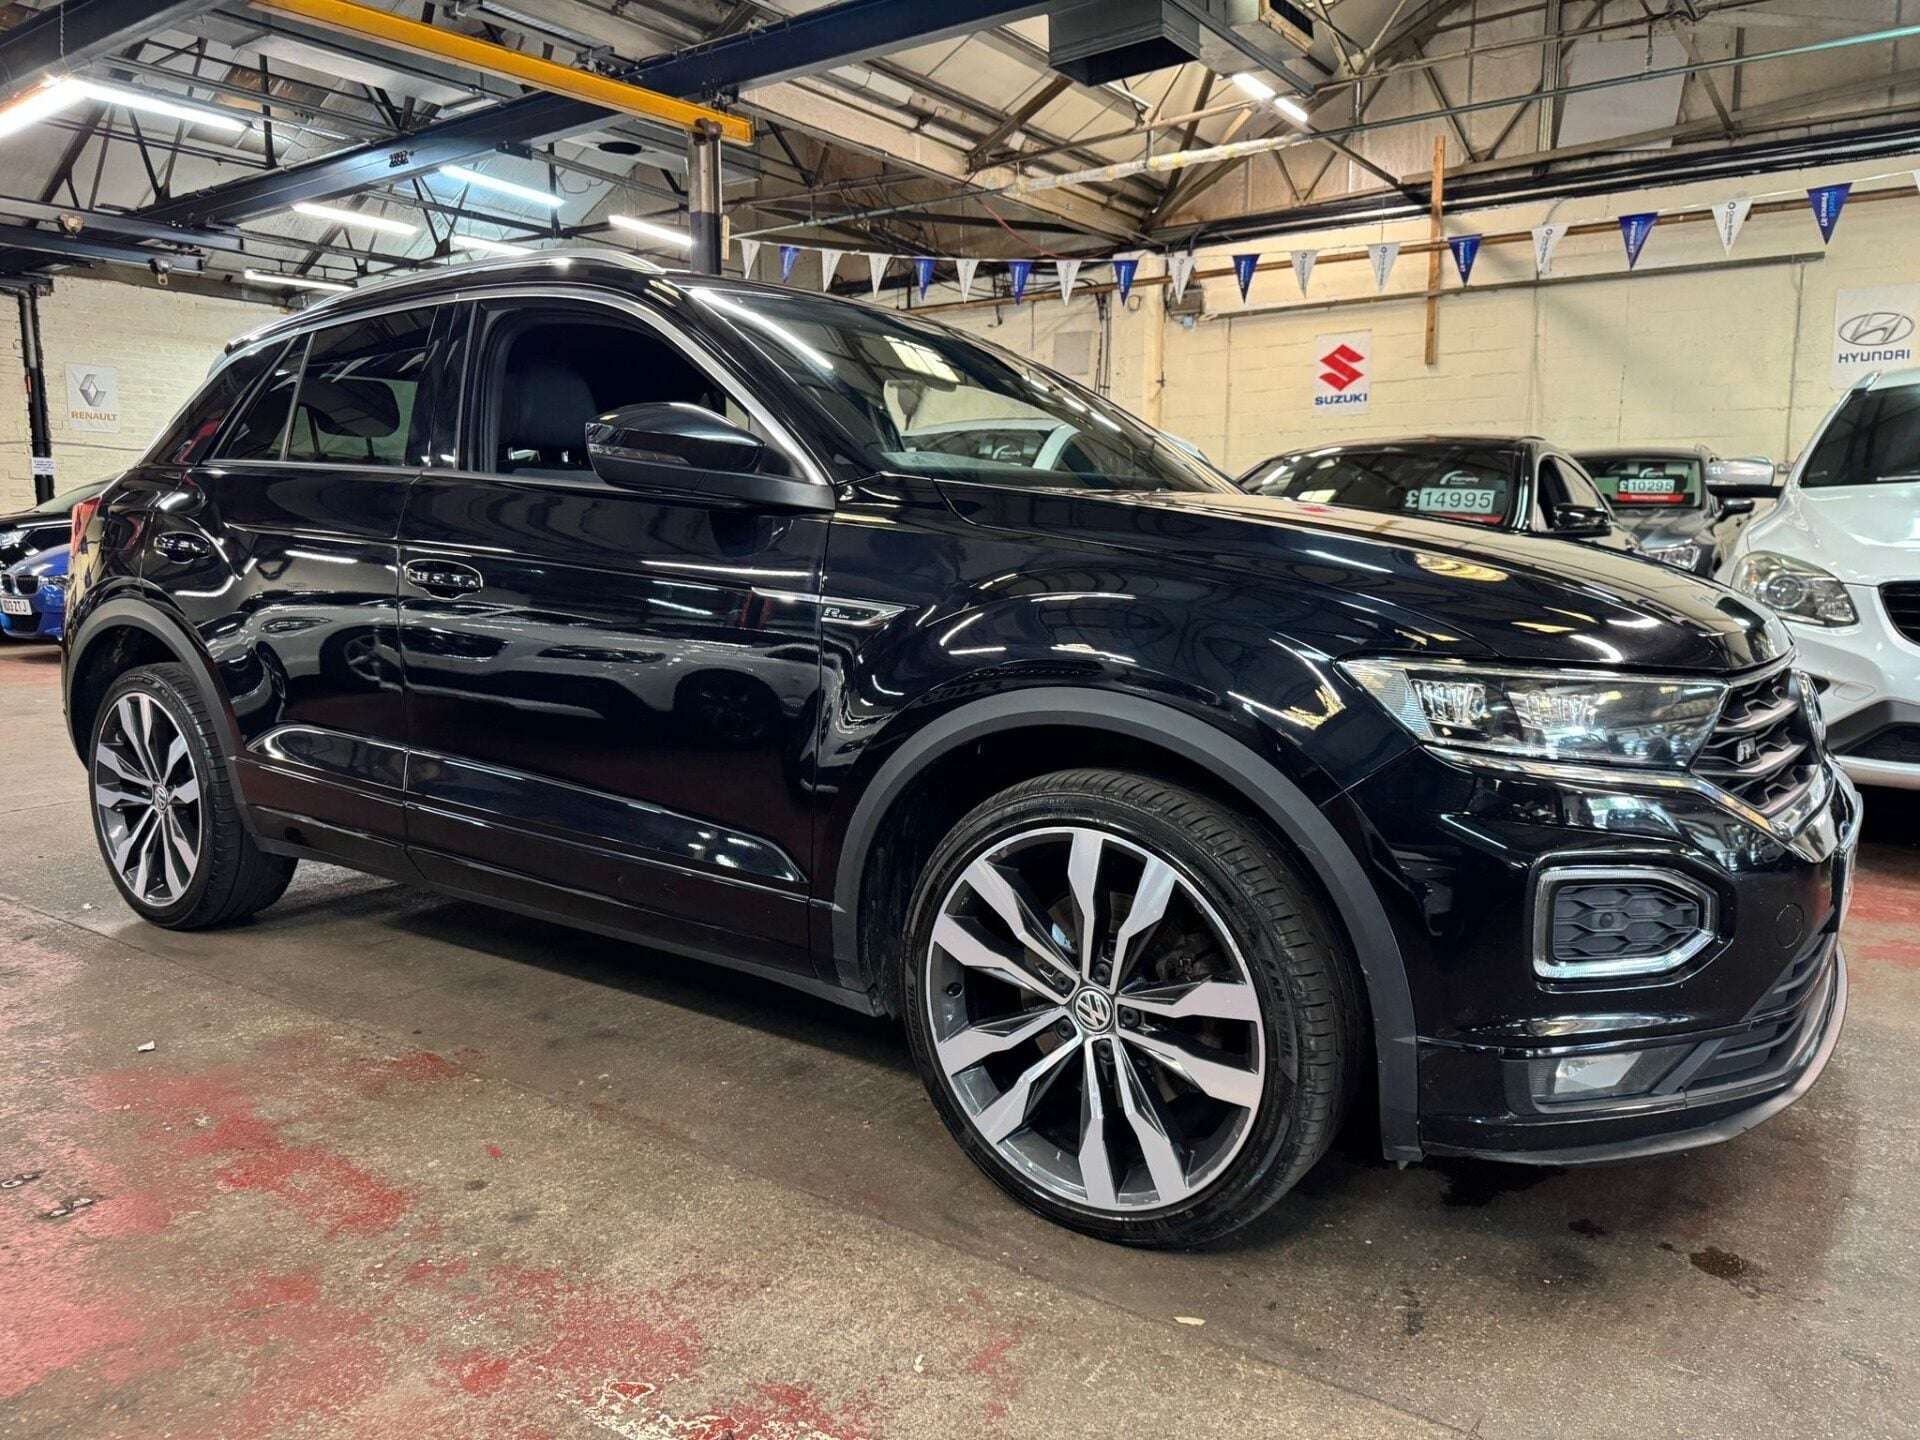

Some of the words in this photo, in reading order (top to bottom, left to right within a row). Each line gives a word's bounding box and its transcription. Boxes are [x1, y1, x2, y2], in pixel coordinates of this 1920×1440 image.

[1838, 349, 1910, 363] HYUNDAI
[1314, 393, 1367, 406] SUZUKI
[70, 410, 118, 421] RENAULT
